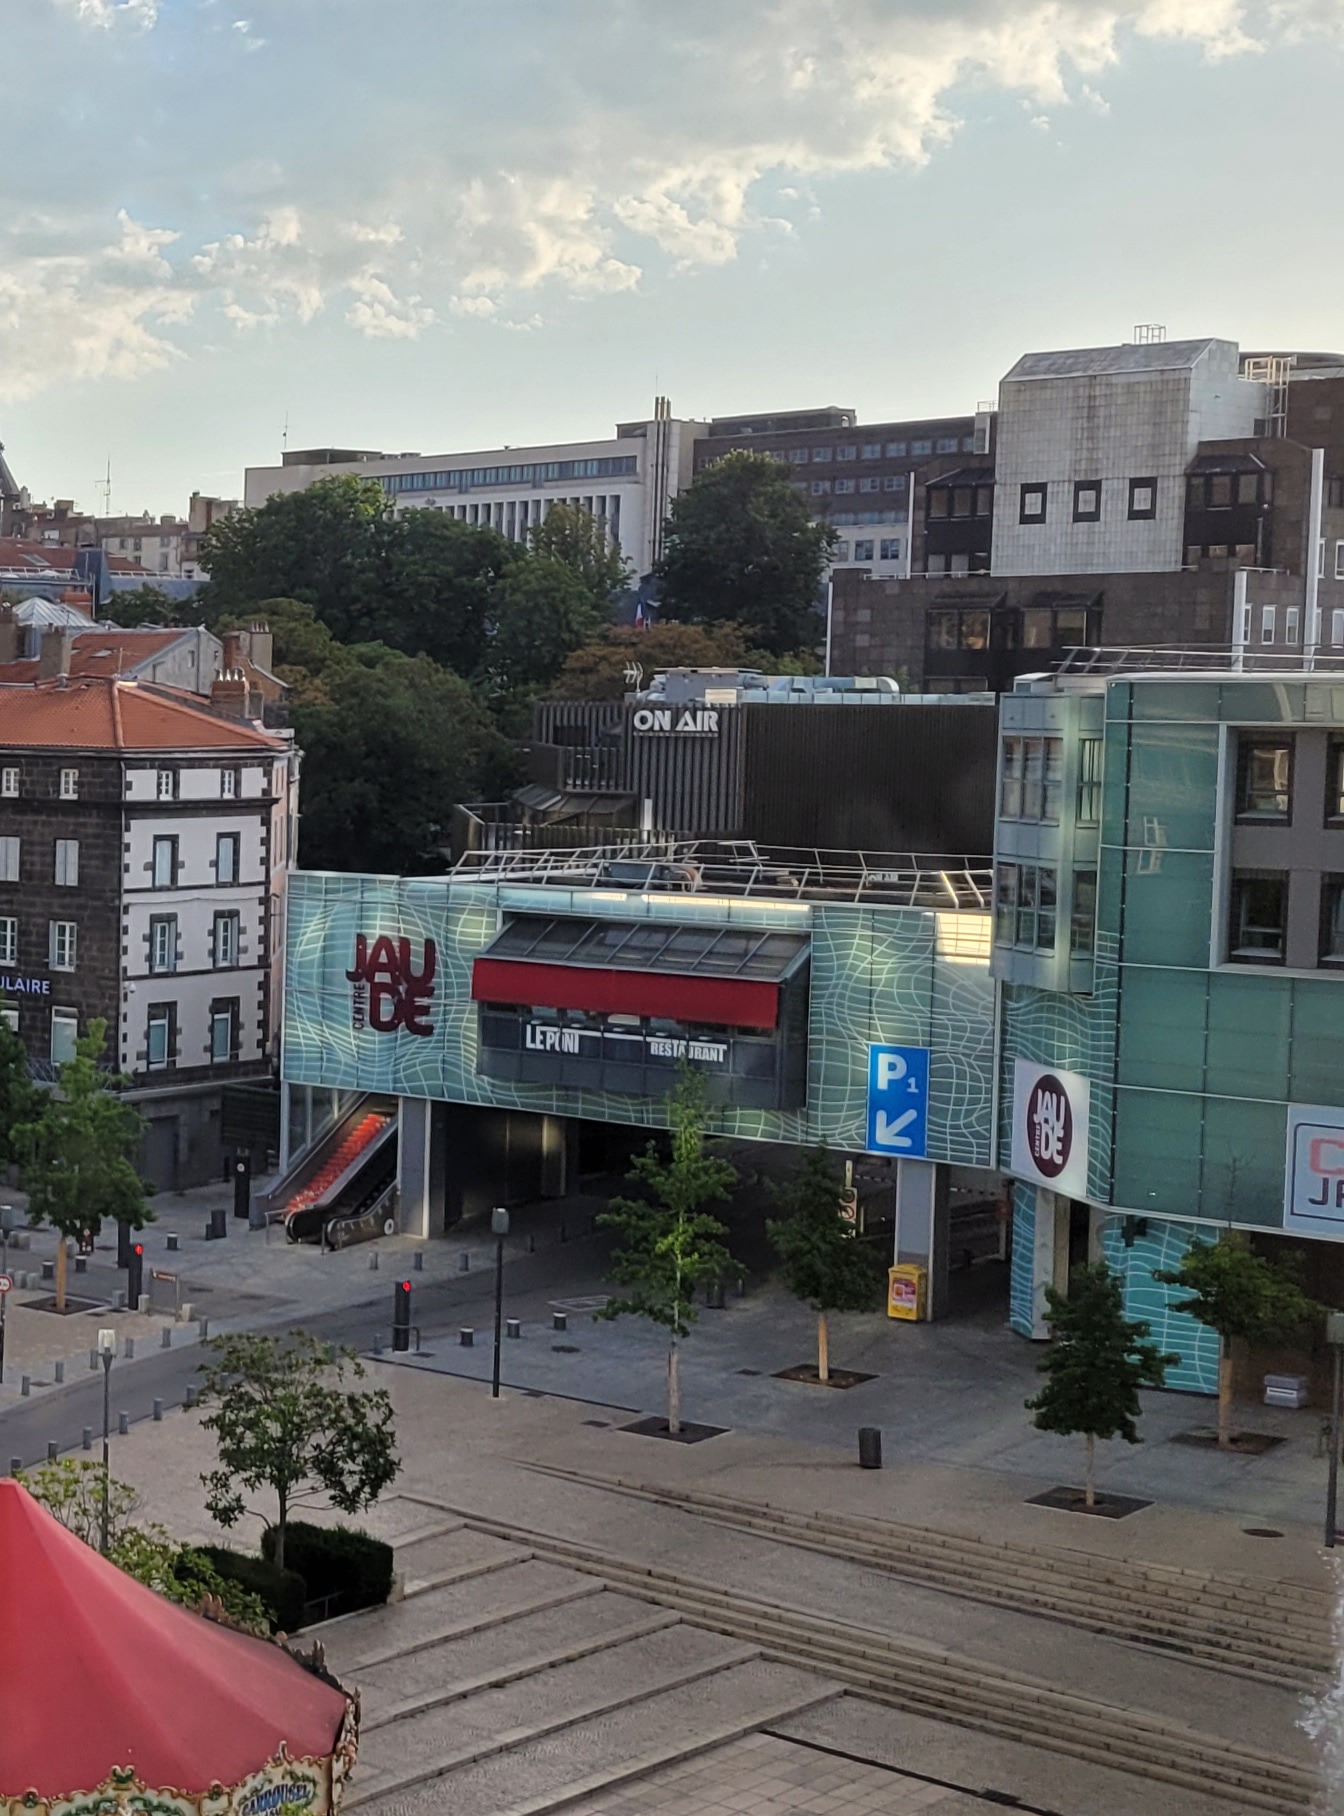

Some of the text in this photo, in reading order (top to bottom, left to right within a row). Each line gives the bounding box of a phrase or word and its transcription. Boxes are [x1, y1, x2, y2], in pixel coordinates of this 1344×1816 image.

[633, 709, 719, 732] ON AIR
[353, 983, 365, 1030] CENTRE
[526, 1024, 580, 1054] LE PONT
[1034, 1123, 1042, 1157] CENTRE
